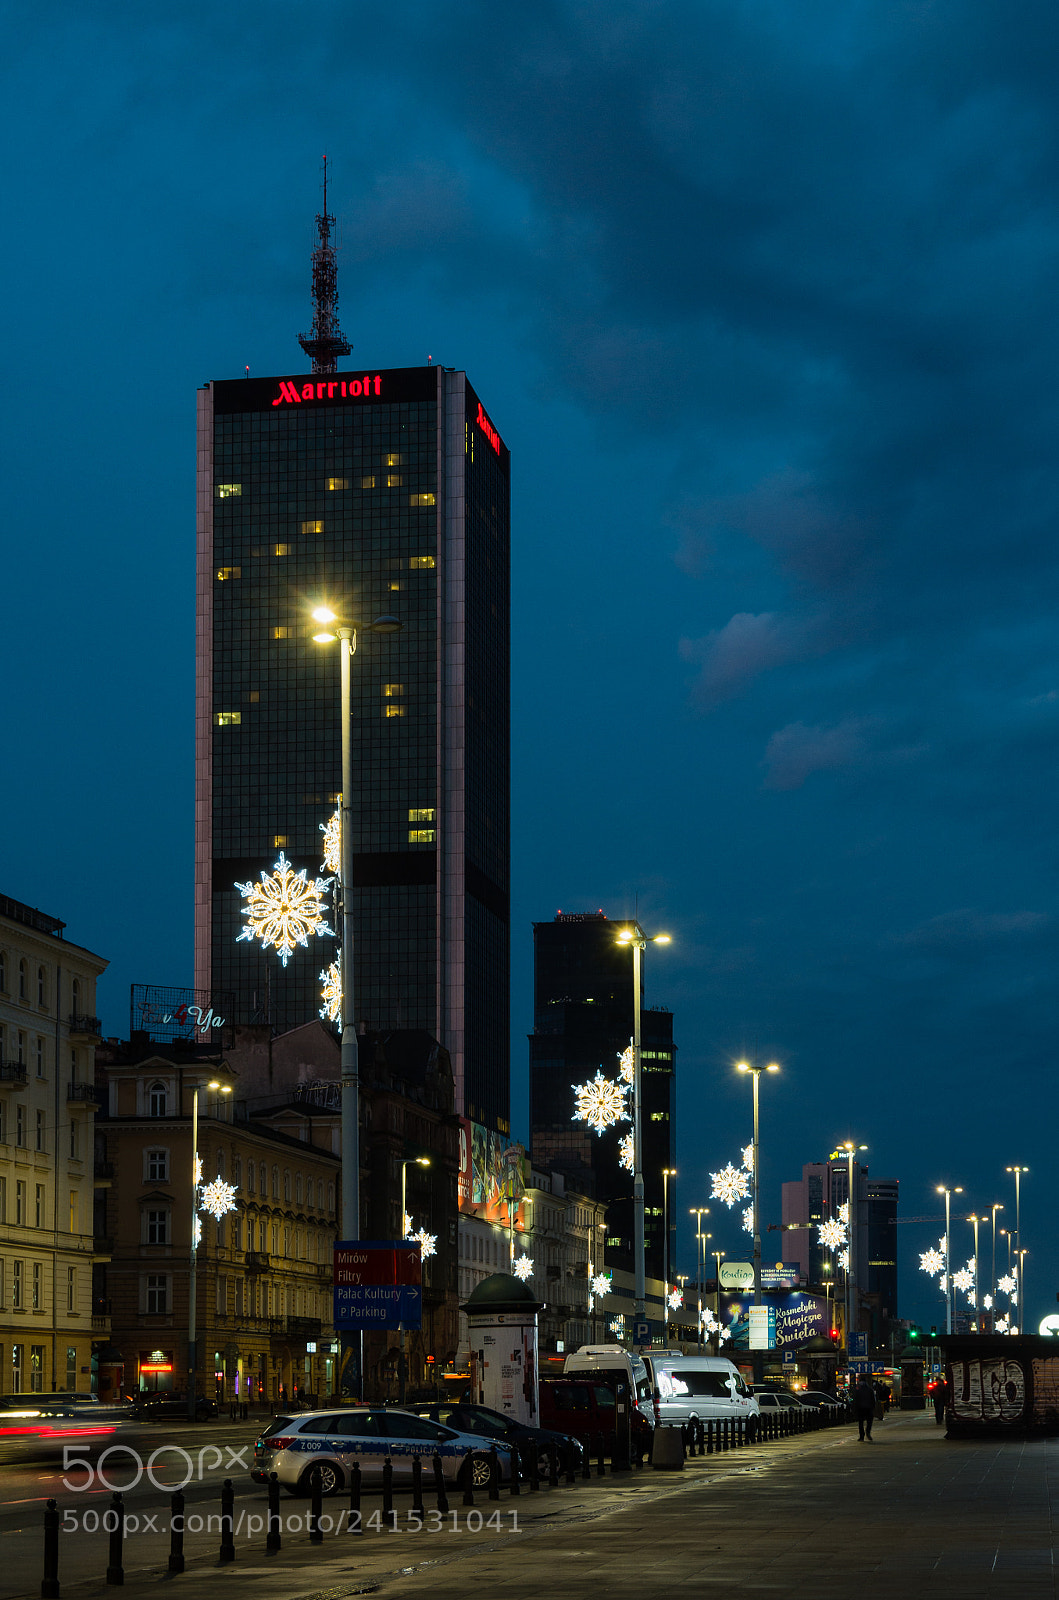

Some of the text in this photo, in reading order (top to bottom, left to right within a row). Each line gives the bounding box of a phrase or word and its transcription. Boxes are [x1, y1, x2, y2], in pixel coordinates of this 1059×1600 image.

[272, 375, 383, 406] Marriott
[338, 1252, 368, 1264] Mirów
[338, 1270, 361, 1285] Filtry
[338, 1287, 402, 1302] Pałac Kultury
[350, 1305, 387, 1320] Parking
[775, 1300, 817, 1320] Kosmetyki
[781, 1312, 822, 1330] Magiczne
[775, 1323, 817, 1346] Święta
[405, 1445, 438, 1455] POLICJA
